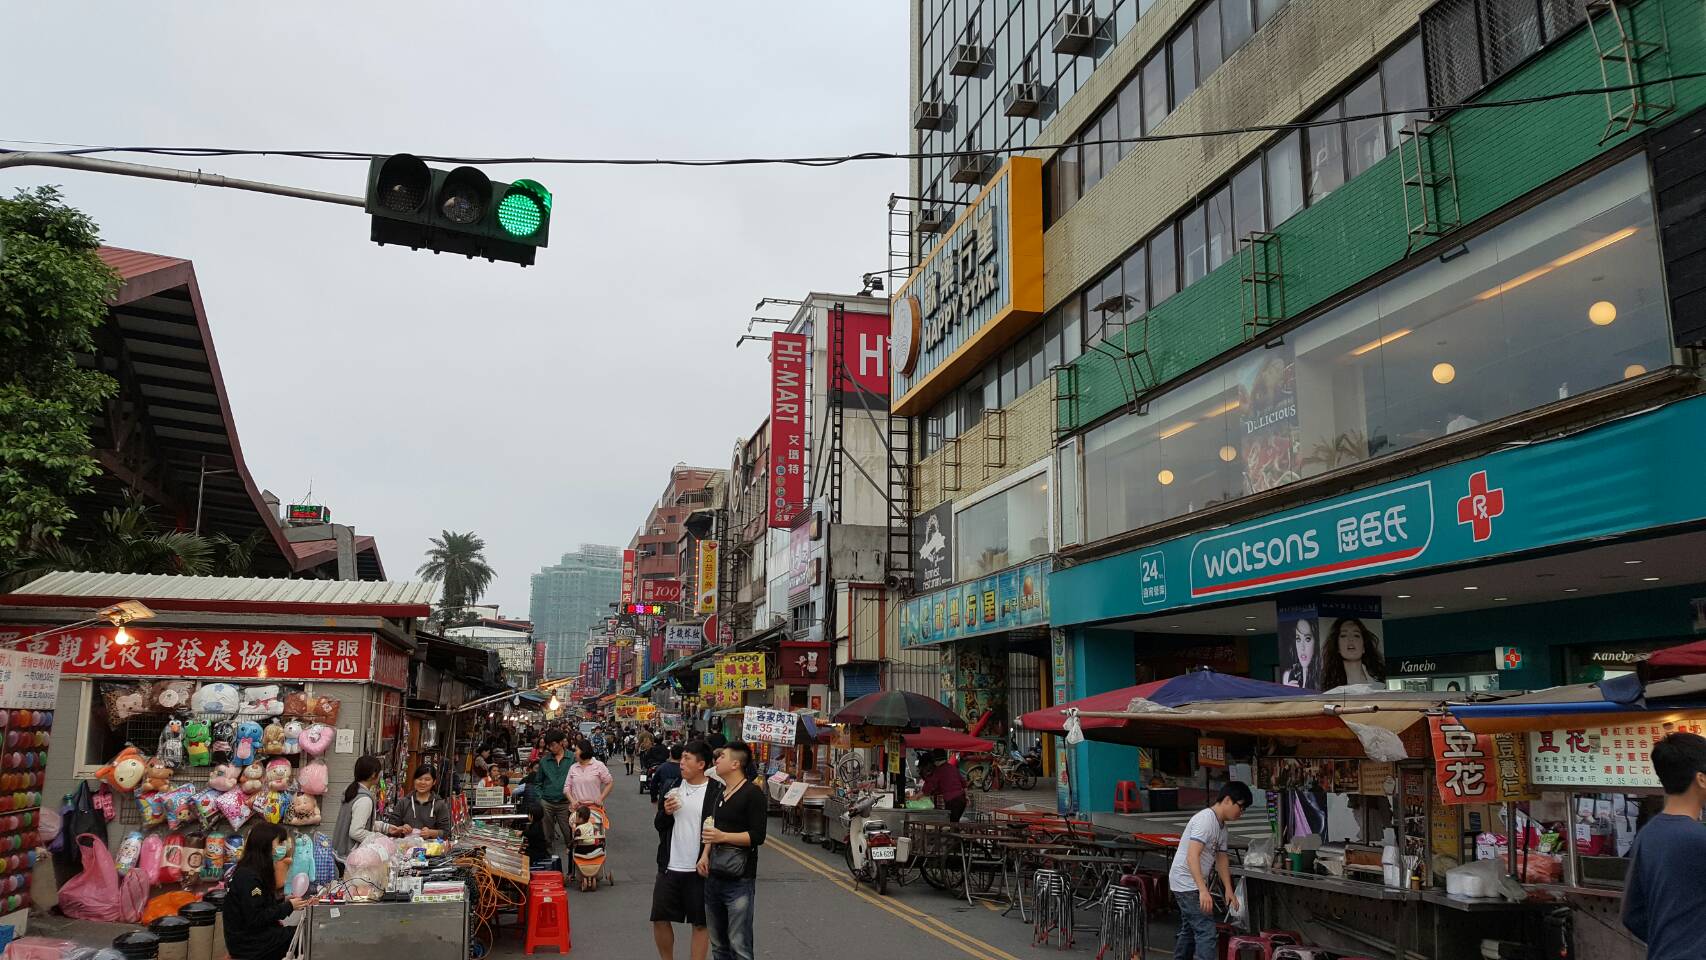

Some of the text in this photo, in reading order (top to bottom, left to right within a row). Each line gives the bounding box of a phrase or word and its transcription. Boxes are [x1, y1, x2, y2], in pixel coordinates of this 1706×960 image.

[924, 262, 999, 352] HAPPY STAR
[776, 341, 802, 424] Hi-MART
[1203, 504, 1408, 579] watsons 屈臣氏
[1142, 559, 1159, 582] 24
[311, 639, 359, 657] 客服
[310, 658, 358, 675] 中心
[1400, 660, 1437, 673] Kanebo
[757, 711, 795, 725] 客家肉丸
[1537, 728, 1591, 754] 豆花
[1439, 724, 1487, 797] 豆花
